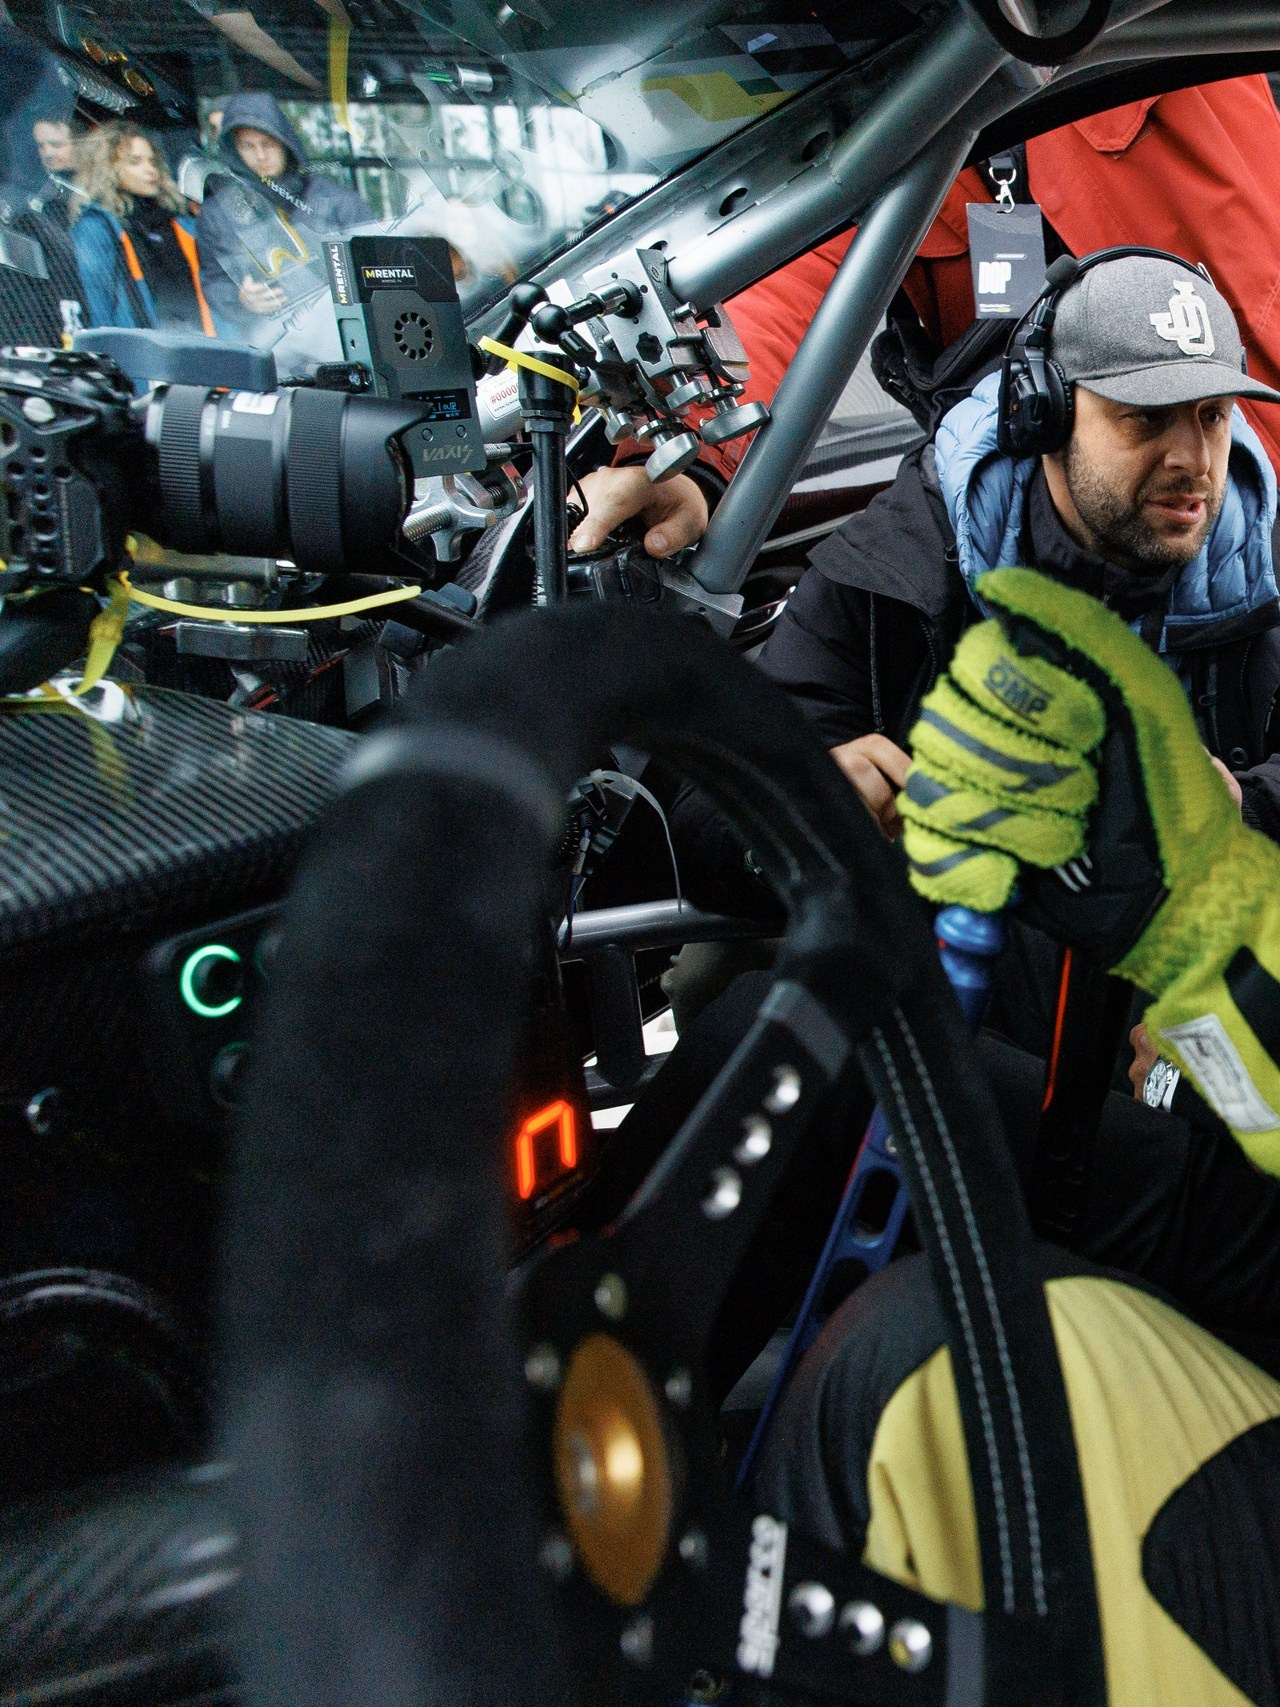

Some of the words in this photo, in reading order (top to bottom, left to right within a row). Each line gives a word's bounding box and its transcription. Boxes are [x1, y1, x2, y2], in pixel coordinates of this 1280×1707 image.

[331, 245, 348, 304] MRENTAL
[365, 269, 414, 279] MRENTAL
[985, 662, 1049, 716] OMP
